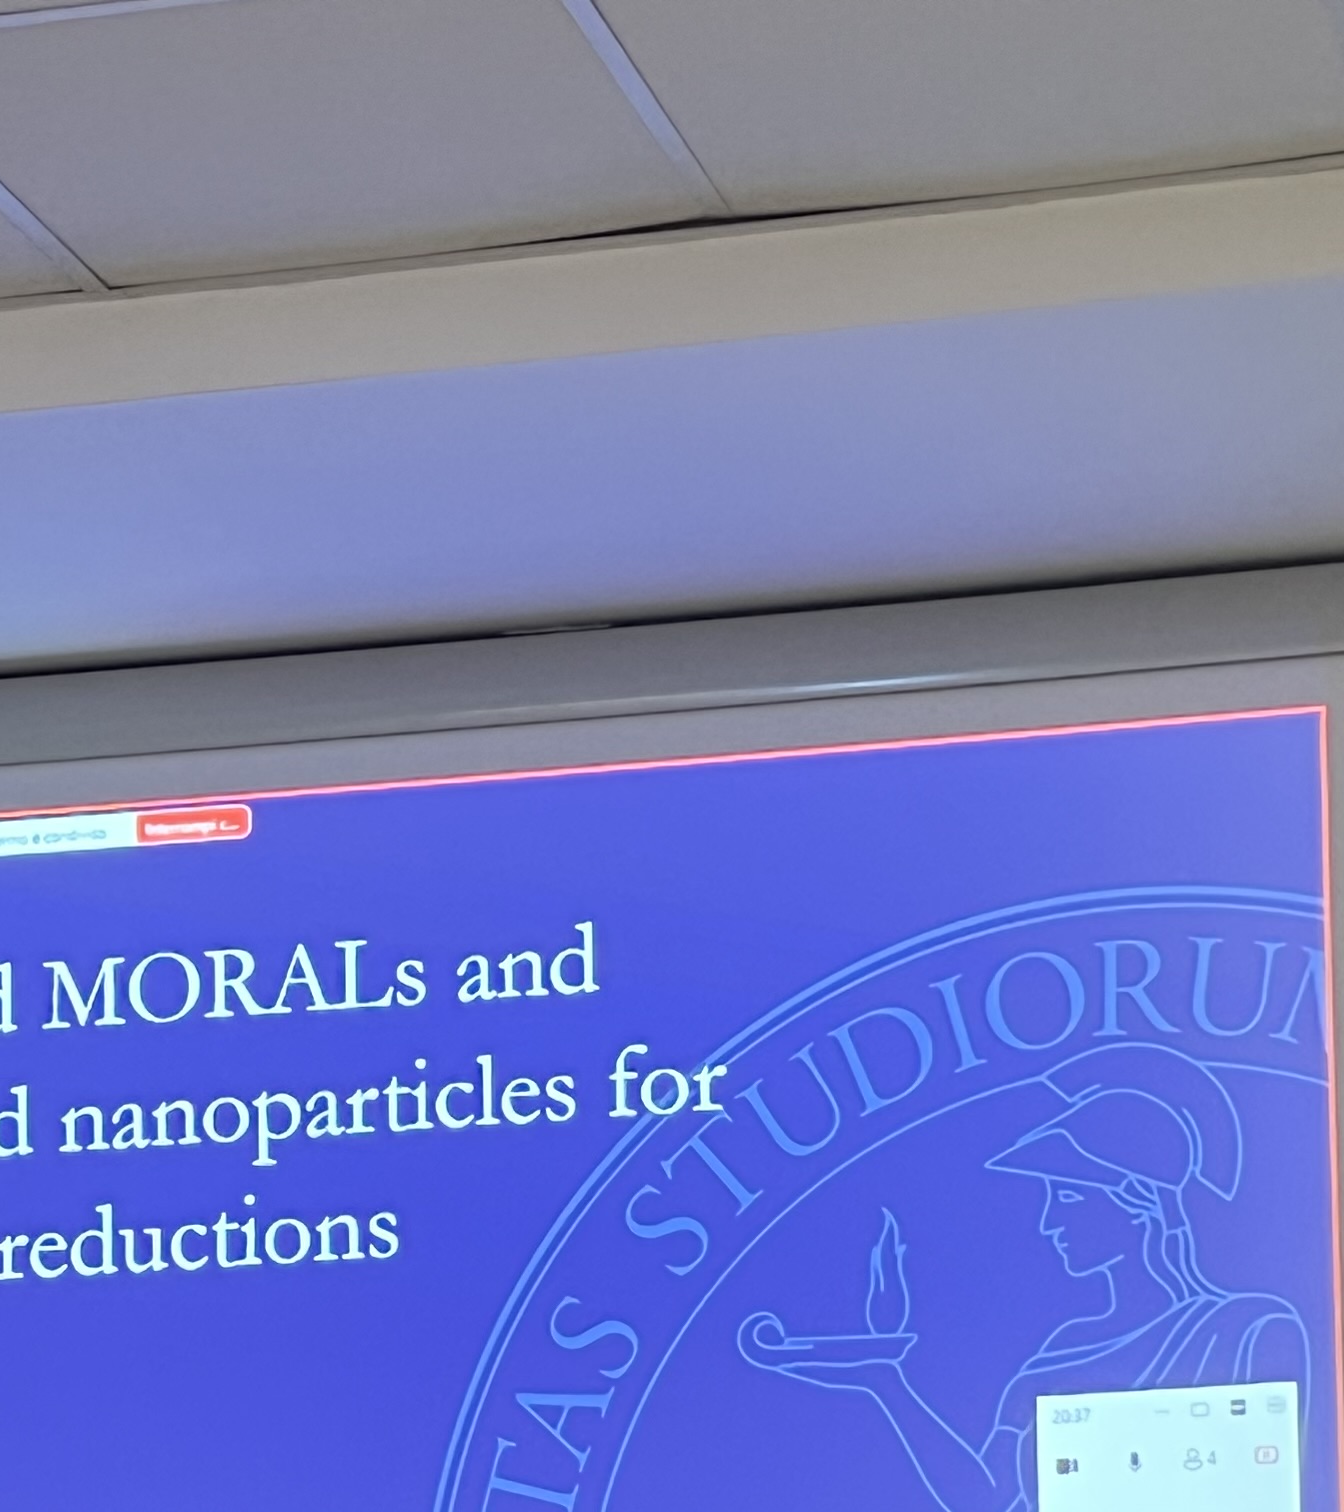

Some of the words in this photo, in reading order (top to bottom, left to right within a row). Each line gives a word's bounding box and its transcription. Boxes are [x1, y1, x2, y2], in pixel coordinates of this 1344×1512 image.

[42, 940, 426, 1029] MORALs
[457, 921, 600, 1002] and
[59, 1055, 575, 1166] nanoparticles
[609, 1044, 728, 1121] for
